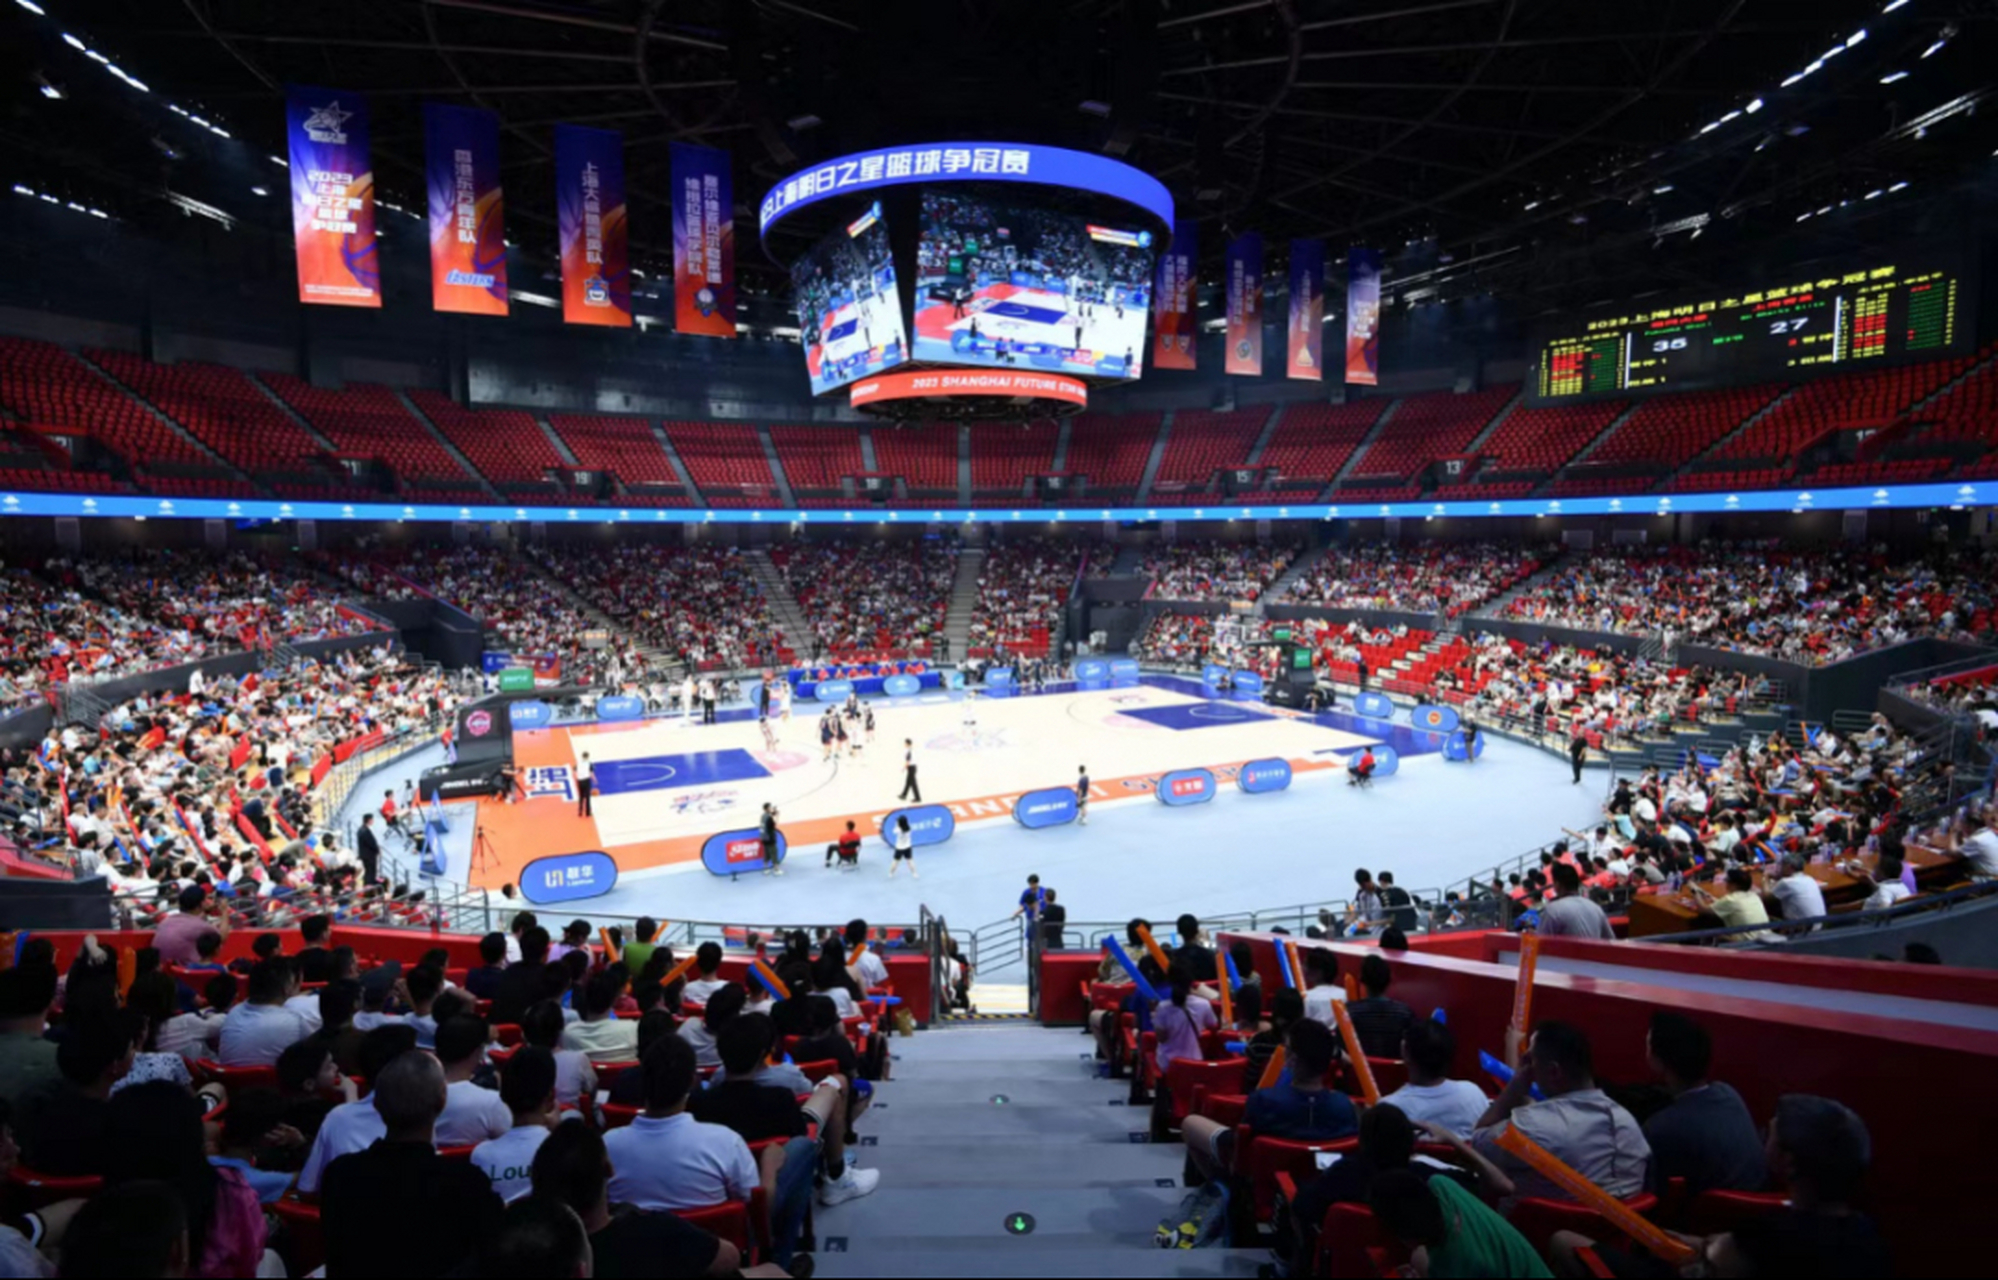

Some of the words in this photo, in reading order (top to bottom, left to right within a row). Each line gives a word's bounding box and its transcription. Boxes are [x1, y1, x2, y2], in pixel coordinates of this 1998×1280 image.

[1769, 317, 1809, 334] 27
[941, 376, 1010, 387] SHANGHAI
[1014, 377, 1056, 390] FUTURE
[1446, 461, 1460, 474] 13
[1236, 470, 1248, 483] 15
